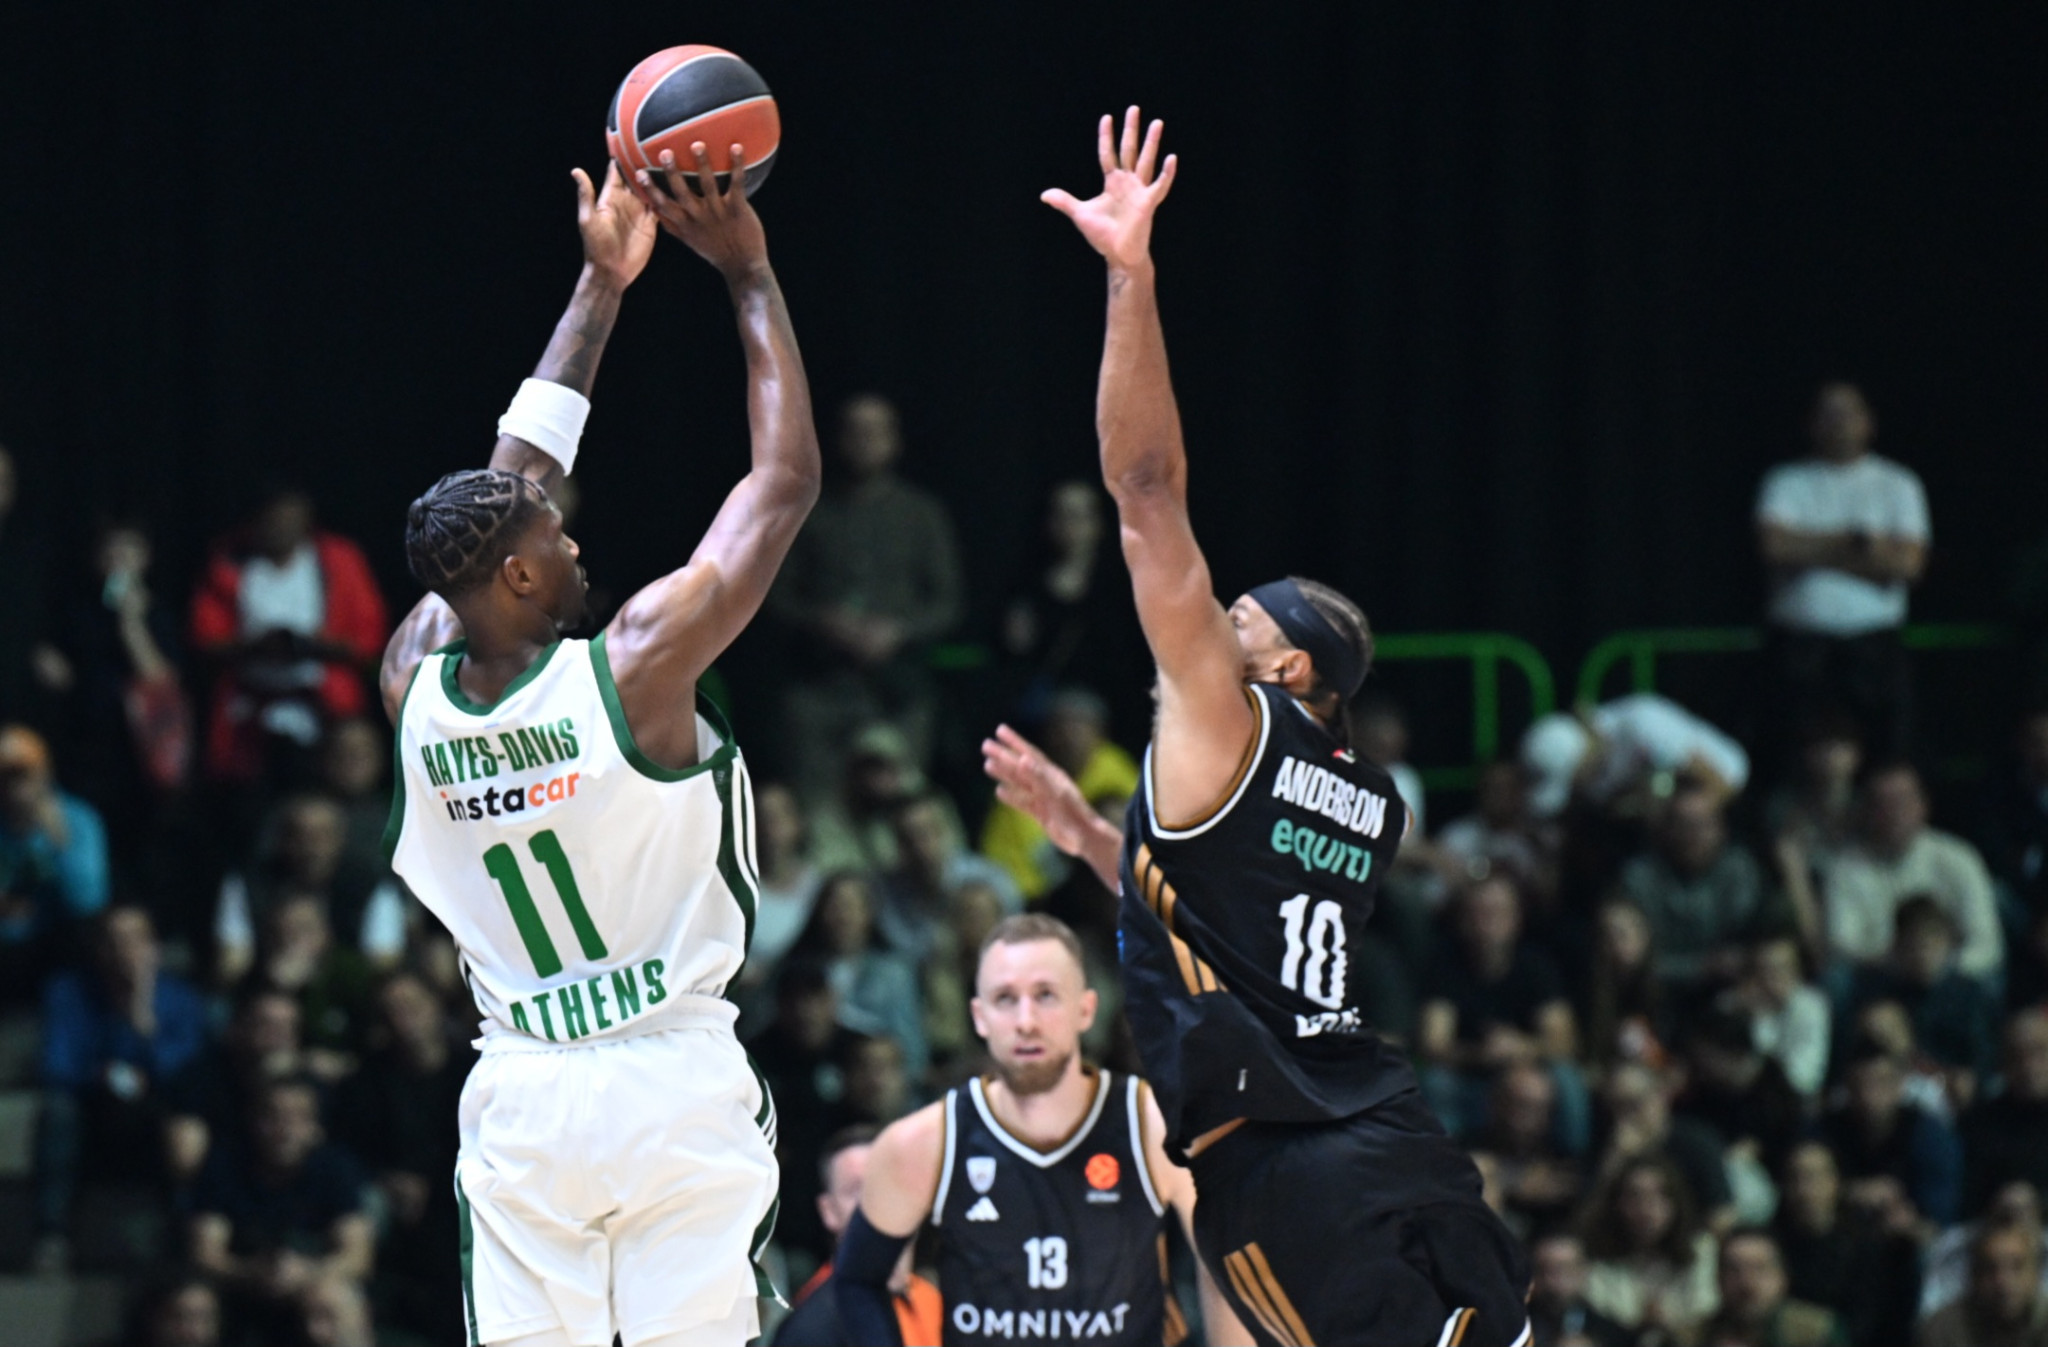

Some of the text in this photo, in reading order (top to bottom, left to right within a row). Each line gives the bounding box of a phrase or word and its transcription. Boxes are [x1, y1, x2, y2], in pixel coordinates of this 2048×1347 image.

[421, 717, 580, 787] HAYES-DAVIS
[440, 772, 580, 821] instacar
[1272, 755, 1387, 839] ANDERSON
[483, 829, 608, 979] 11
[1279, 893, 1349, 1010] 10
[509, 958, 667, 1042] ATHENS
[1023, 1236, 1068, 1289] 13
[953, 1302, 1130, 1339] OMNIYAT
